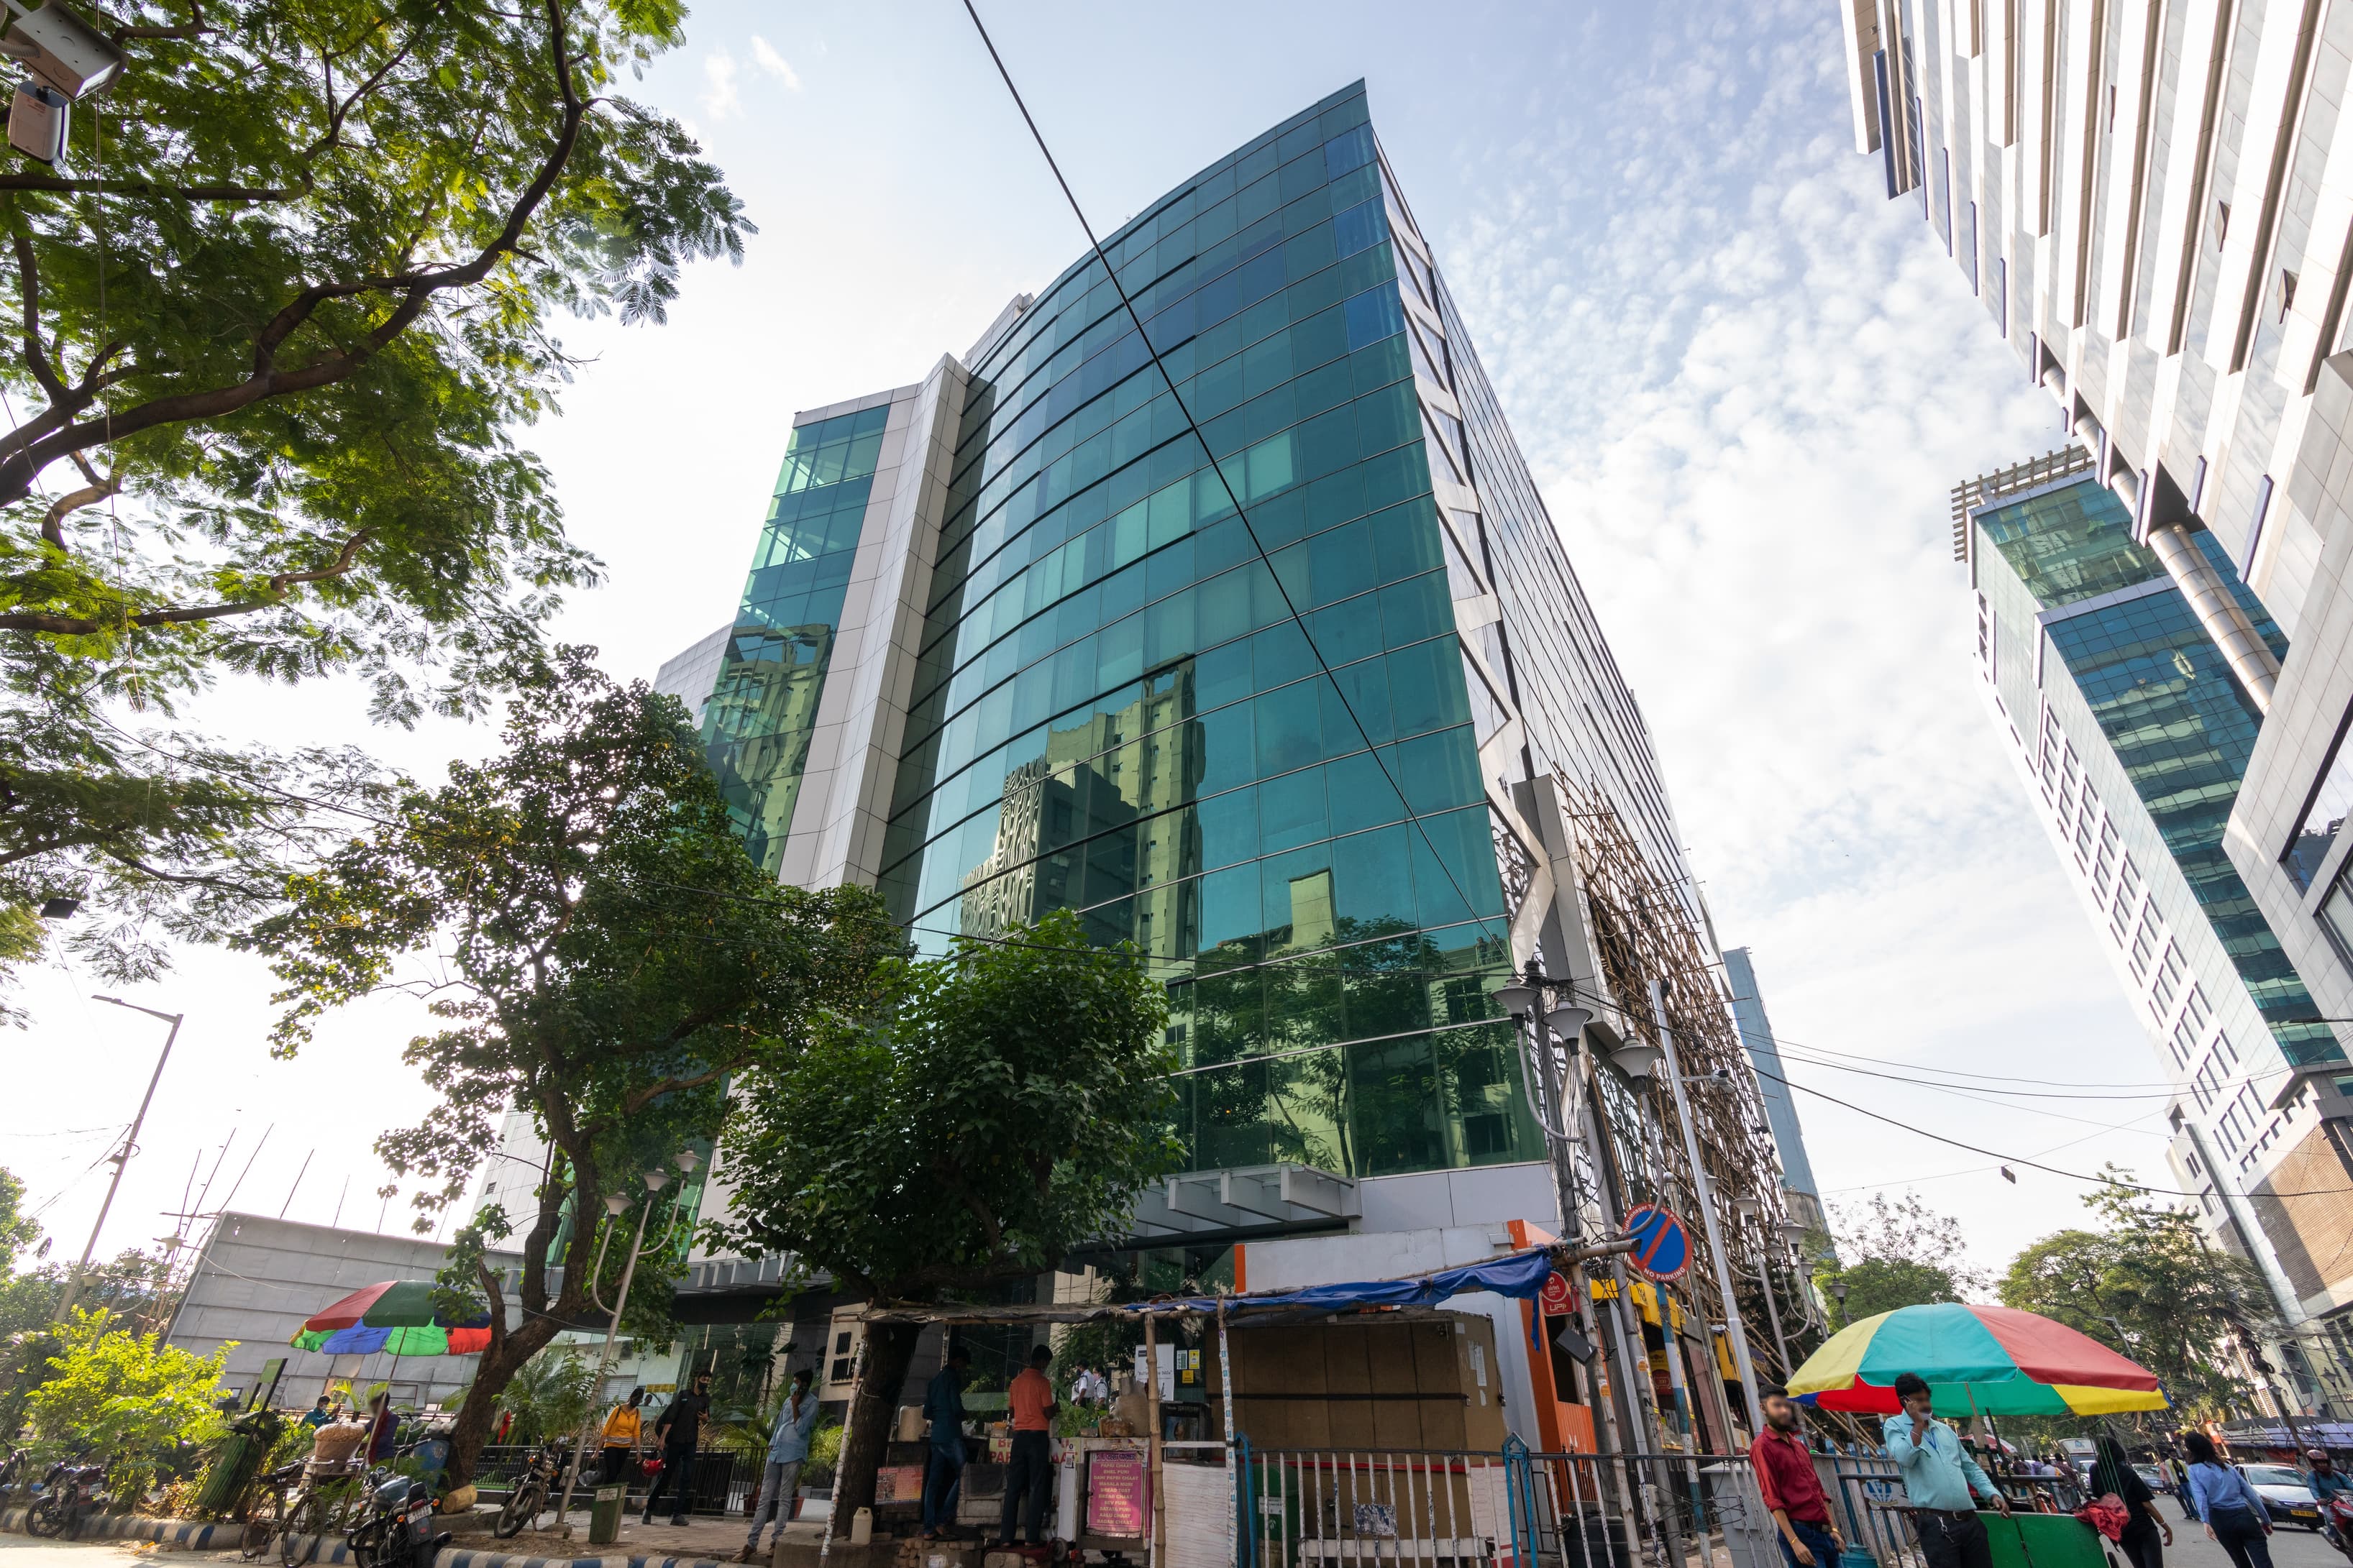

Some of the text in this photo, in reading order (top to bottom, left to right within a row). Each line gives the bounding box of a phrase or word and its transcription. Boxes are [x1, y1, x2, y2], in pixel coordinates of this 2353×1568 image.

[1669, 1214, 1685, 1233] Police
[1644, 1266, 1686, 1281] NO PARKING
[1550, 1303, 1564, 1311] UPI
